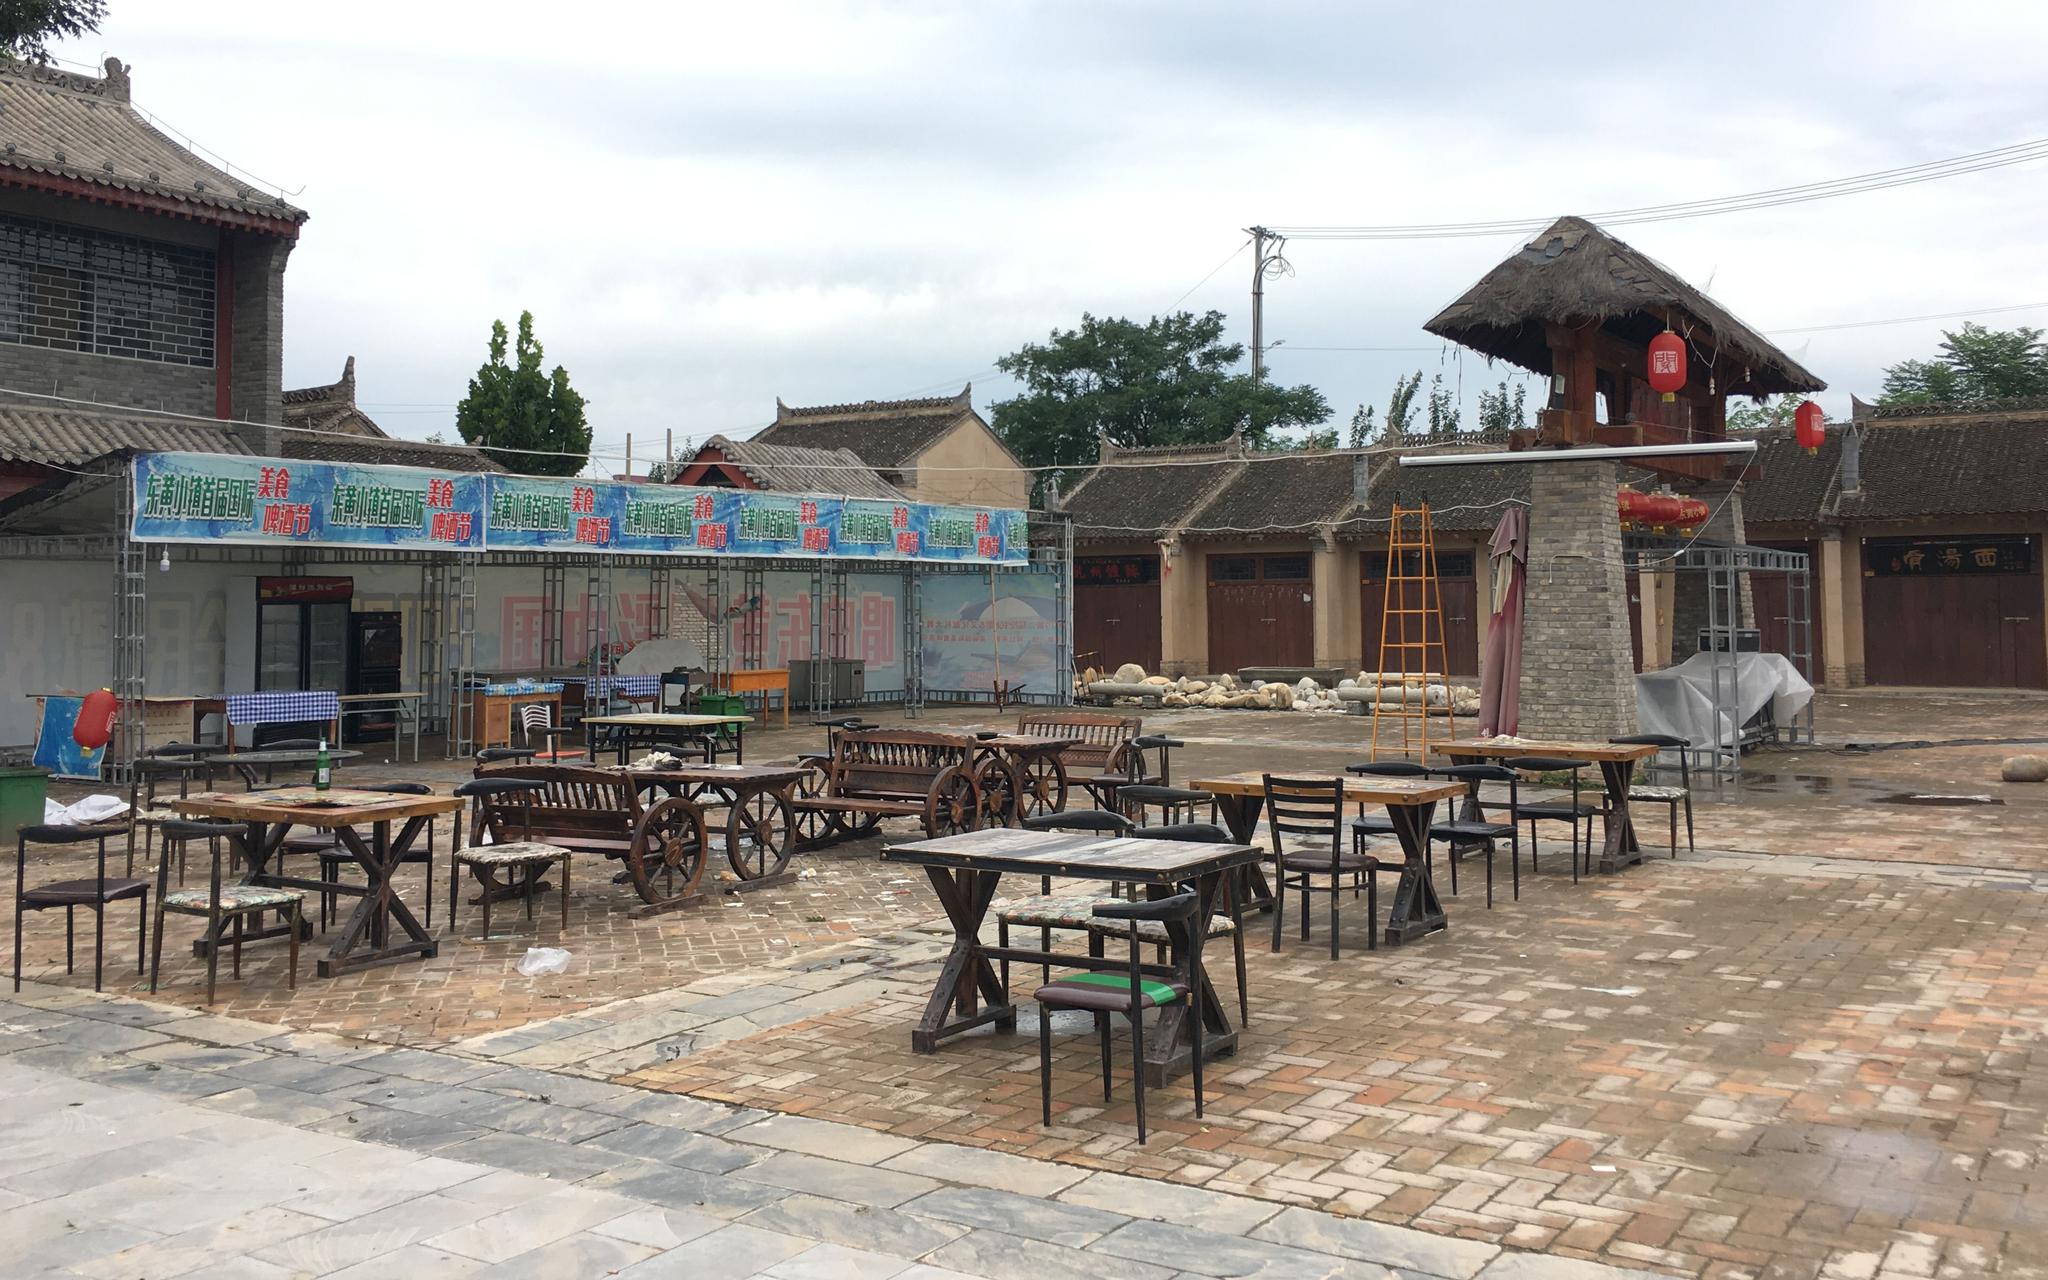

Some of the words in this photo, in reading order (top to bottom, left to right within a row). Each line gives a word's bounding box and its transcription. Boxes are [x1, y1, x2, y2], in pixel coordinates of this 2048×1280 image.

[144, 474, 256, 521] 东黄小镇首届国际
[257, 466, 290, 499] 美食
[426, 478, 454, 508] 美食
[330, 483, 425, 529] 东黄小镇首届国际
[490, 491, 571, 532] 东黄小镇首届国际
[571, 486, 594, 514] 美食
[694, 495, 714, 520] 美食
[800, 501, 817, 525] 美食
[262, 503, 312, 536] 啤酒节
[430, 511, 472, 543] 啤酒节
[576, 517, 611, 545] 啤酒节
[697, 523, 727, 549] 啤酒节
[803, 527, 829, 552] 啤酒节
